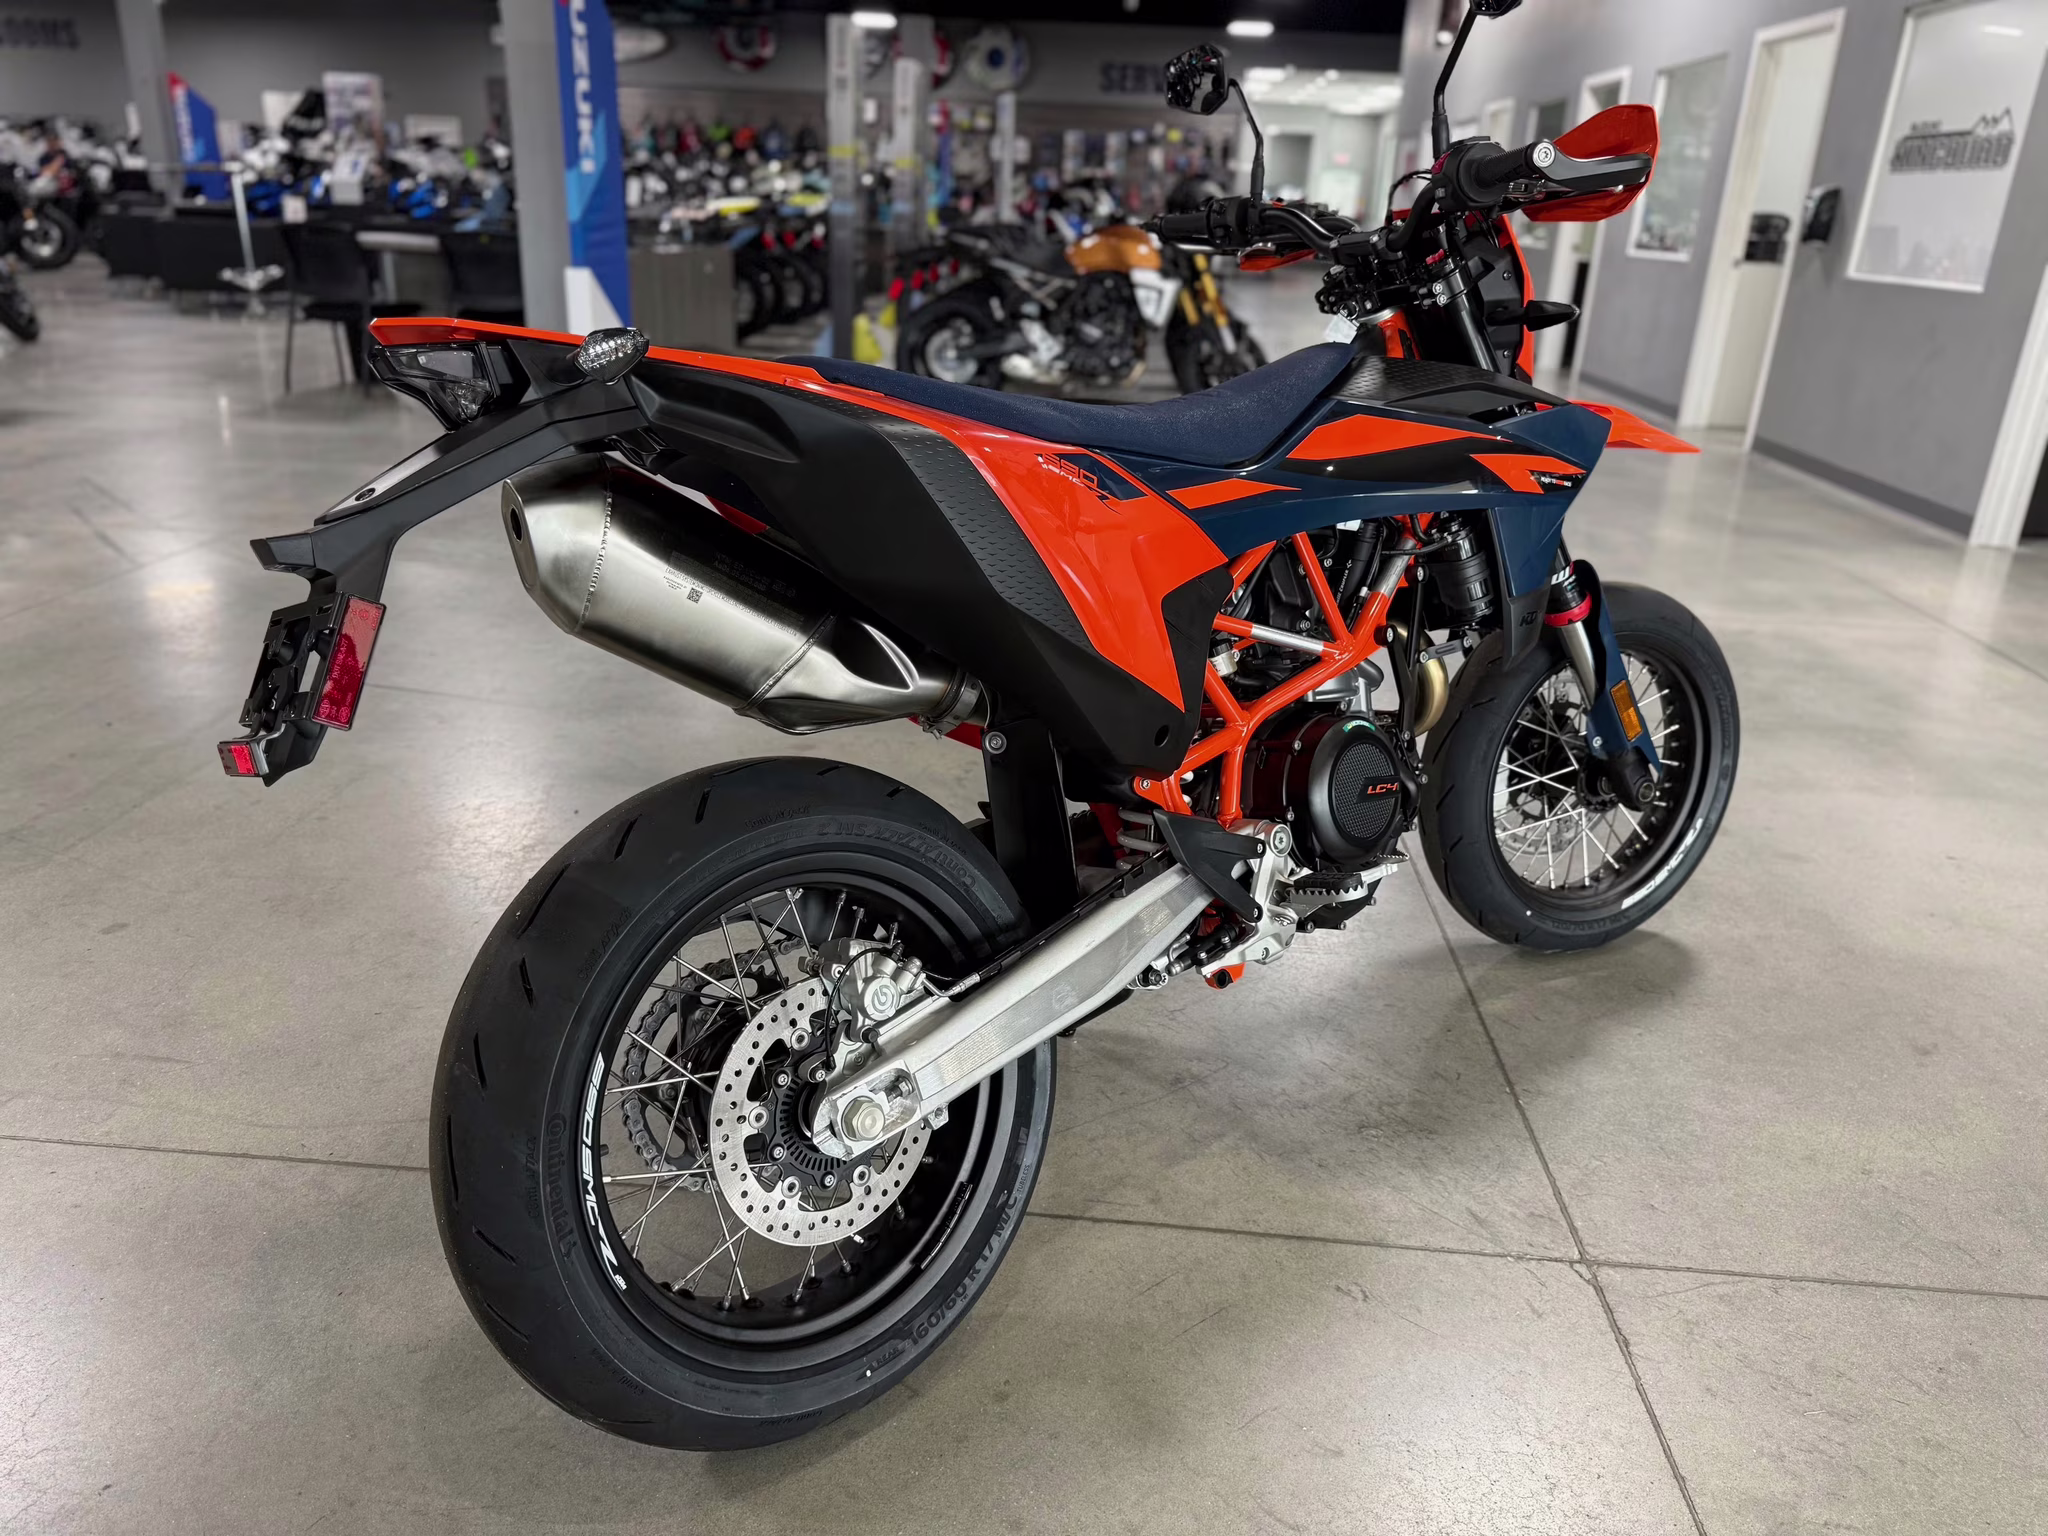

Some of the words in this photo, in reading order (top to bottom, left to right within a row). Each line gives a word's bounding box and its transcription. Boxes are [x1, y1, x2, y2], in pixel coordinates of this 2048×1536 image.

[1367, 781, 1399, 794] LC4
[547, 1112, 574, 1244] Continental
[909, 1281, 968, 1346] 160/60
[979, 1241, 995, 1263] 17
[993, 1196, 1018, 1238] M/C
